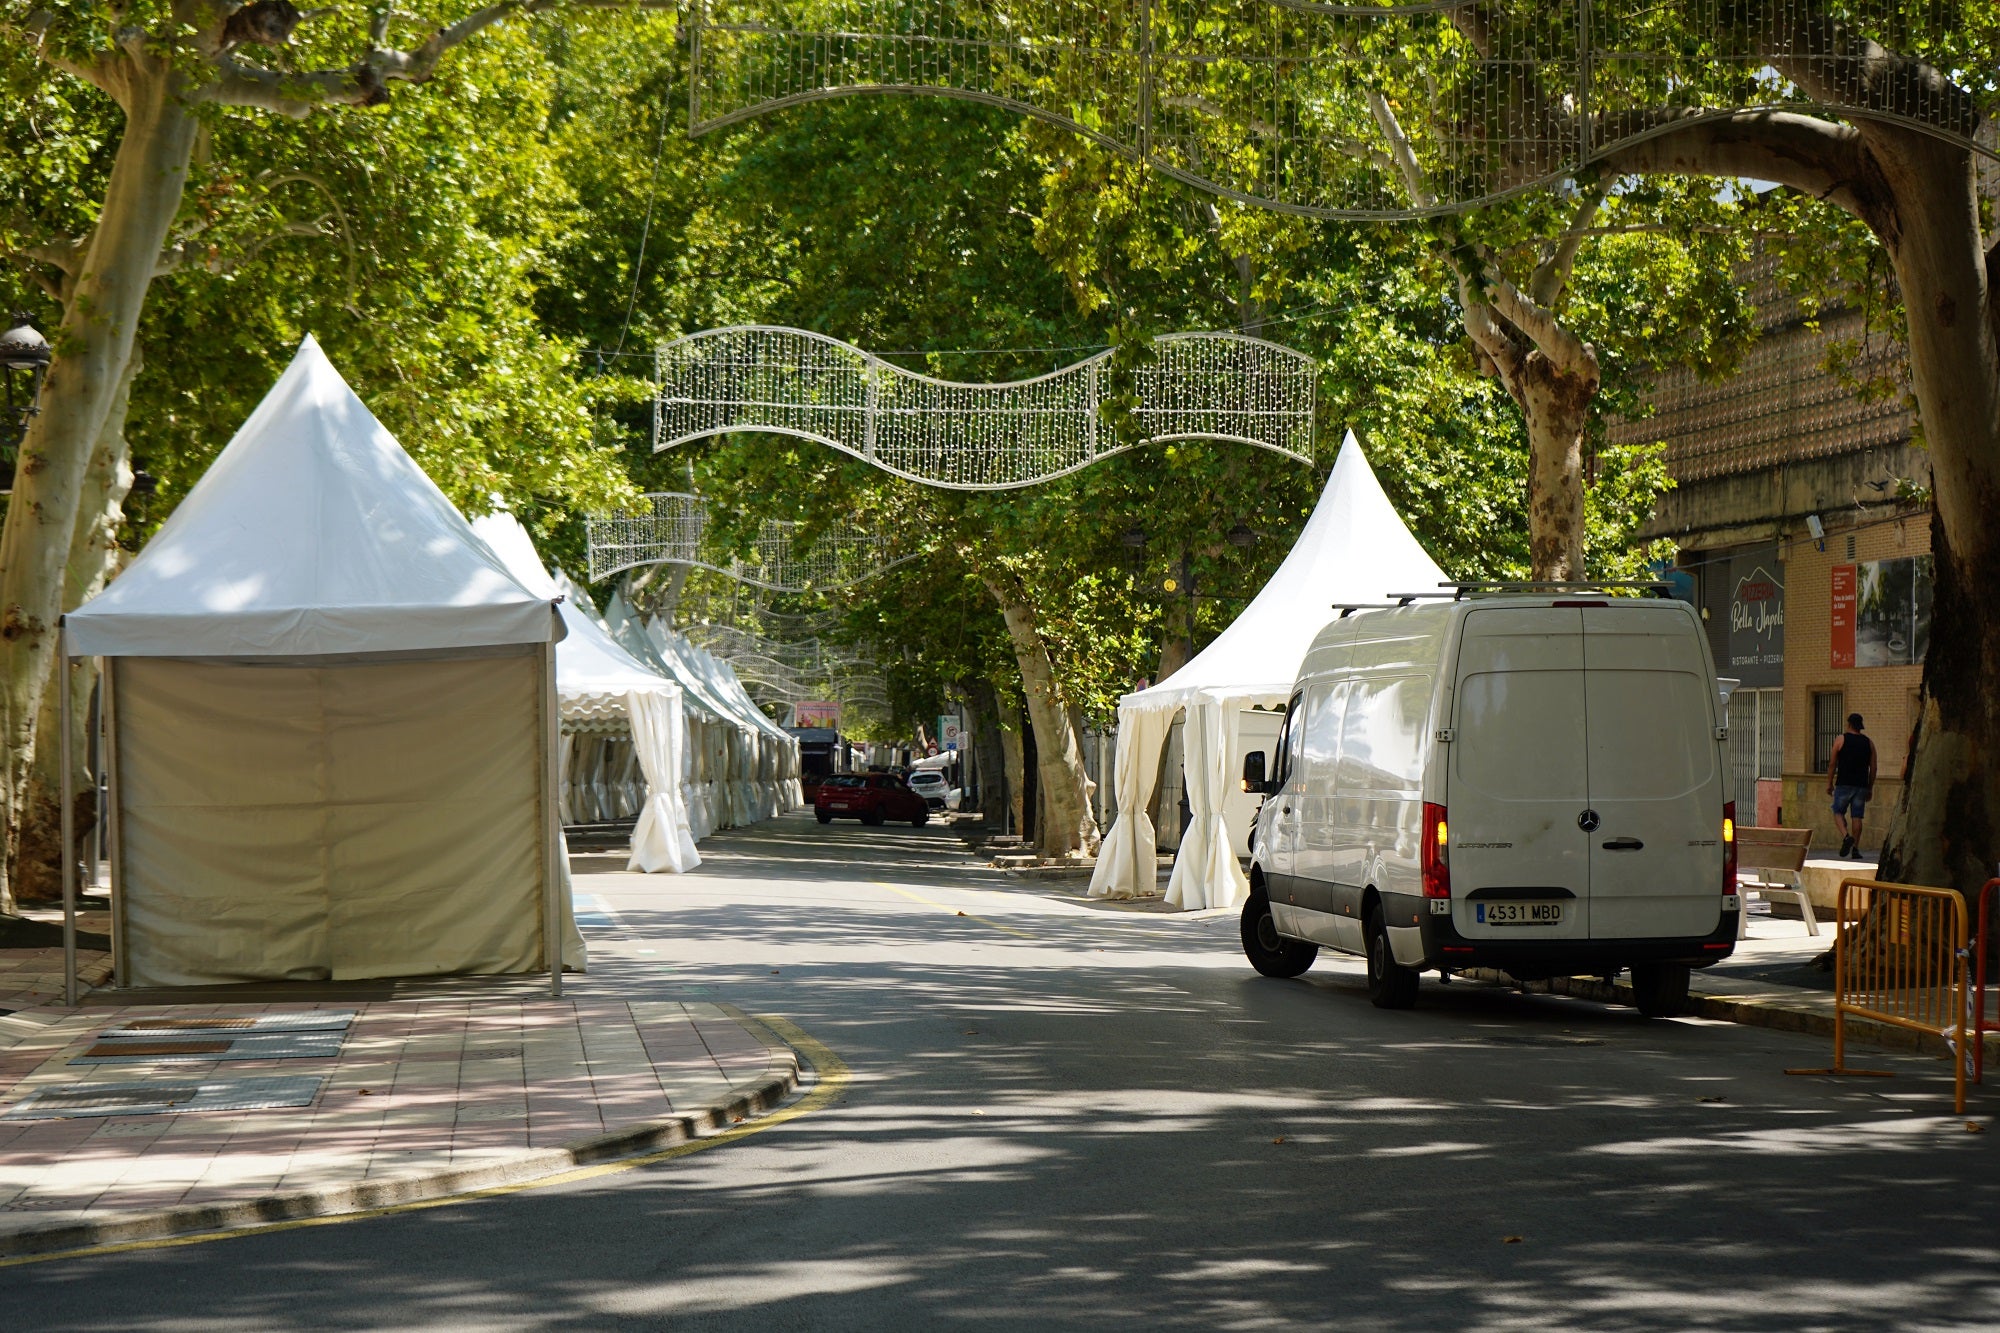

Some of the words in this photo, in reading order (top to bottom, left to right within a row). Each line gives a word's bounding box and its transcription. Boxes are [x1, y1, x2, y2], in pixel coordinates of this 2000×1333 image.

[1742, 583, 1774, 602] PIZZERIA
[1731, 600, 1753, 633] Bella
[1756, 600, 1784, 641] Napoli
[1732, 655, 1759, 666] RISTORANTE
[1763, 654, 1784, 665] PIZZERIA
[1488, 905, 1526, 920] 4531
[1532, 905, 1560, 920] MBD
